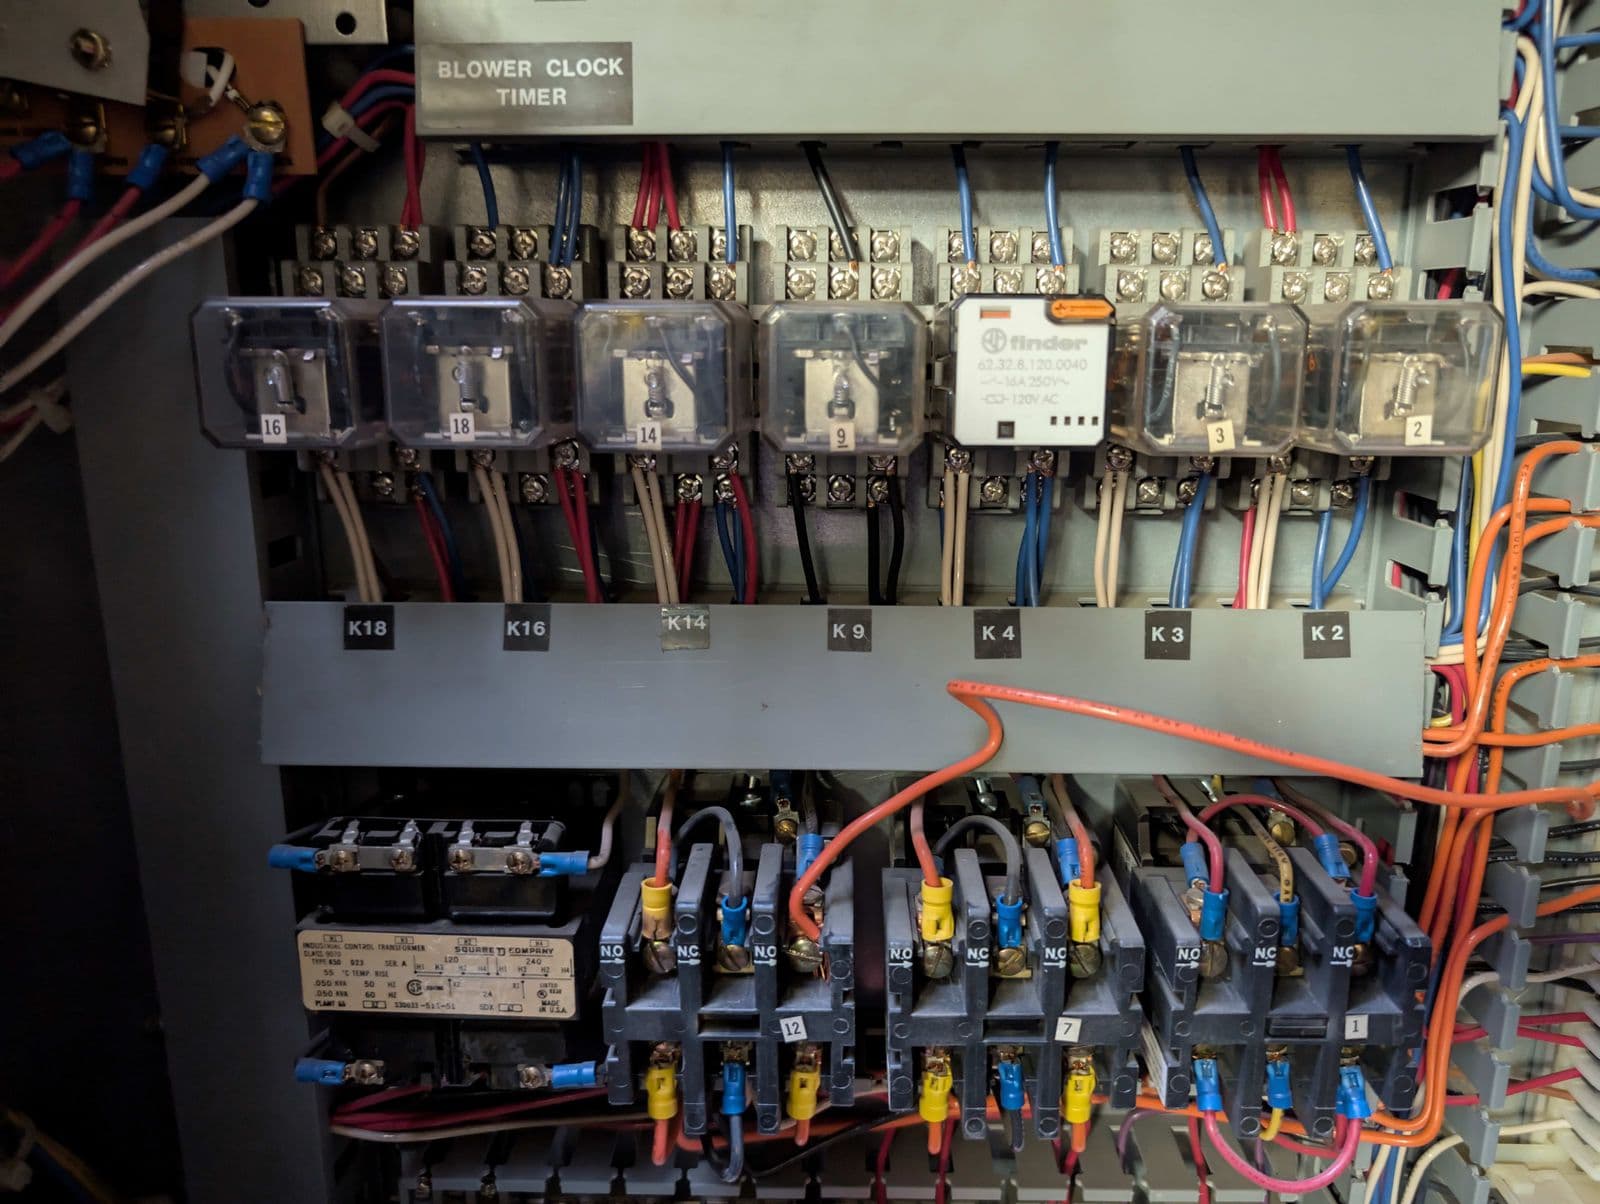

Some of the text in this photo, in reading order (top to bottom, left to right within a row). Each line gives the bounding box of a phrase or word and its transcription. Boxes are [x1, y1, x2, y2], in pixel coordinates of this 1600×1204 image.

[437, 57, 624, 79] BLOWER CLOCK
[496, 88, 567, 107] TIMER
[1010, 335, 1088, 351] finder
[263, 418, 282, 436] 16
[452, 417, 470, 434] 18
[1413, 421, 1423, 437] 2
[639, 427, 657, 444] 14
[836, 428, 847, 445] 9
[1215, 427, 1225, 444] 3
[349, 620, 388, 636] K18
[506, 620, 546, 637] K16
[667, 614, 707, 631] K14
[852, 624, 866, 640] 9
[1002, 625, 1016, 641] 4
[1171, 627, 1185, 643] 3
[1331, 625, 1345, 641] 2
[344, 943, 375, 951] CONTROL
[378, 943, 426, 952] TRANSFORMER
[454, 946, 494, 954] SQUARE
[496, 947, 506, 956] D
[444, 956, 459, 964] 120
[526, 958, 542, 966] 240
[364, 980, 375, 988] 50
[365, 990, 376, 999] 60
[784, 1021, 801, 1036] 12
[1063, 1023, 1073, 1036] 7
[1352, 1019, 1360, 1033] 1
